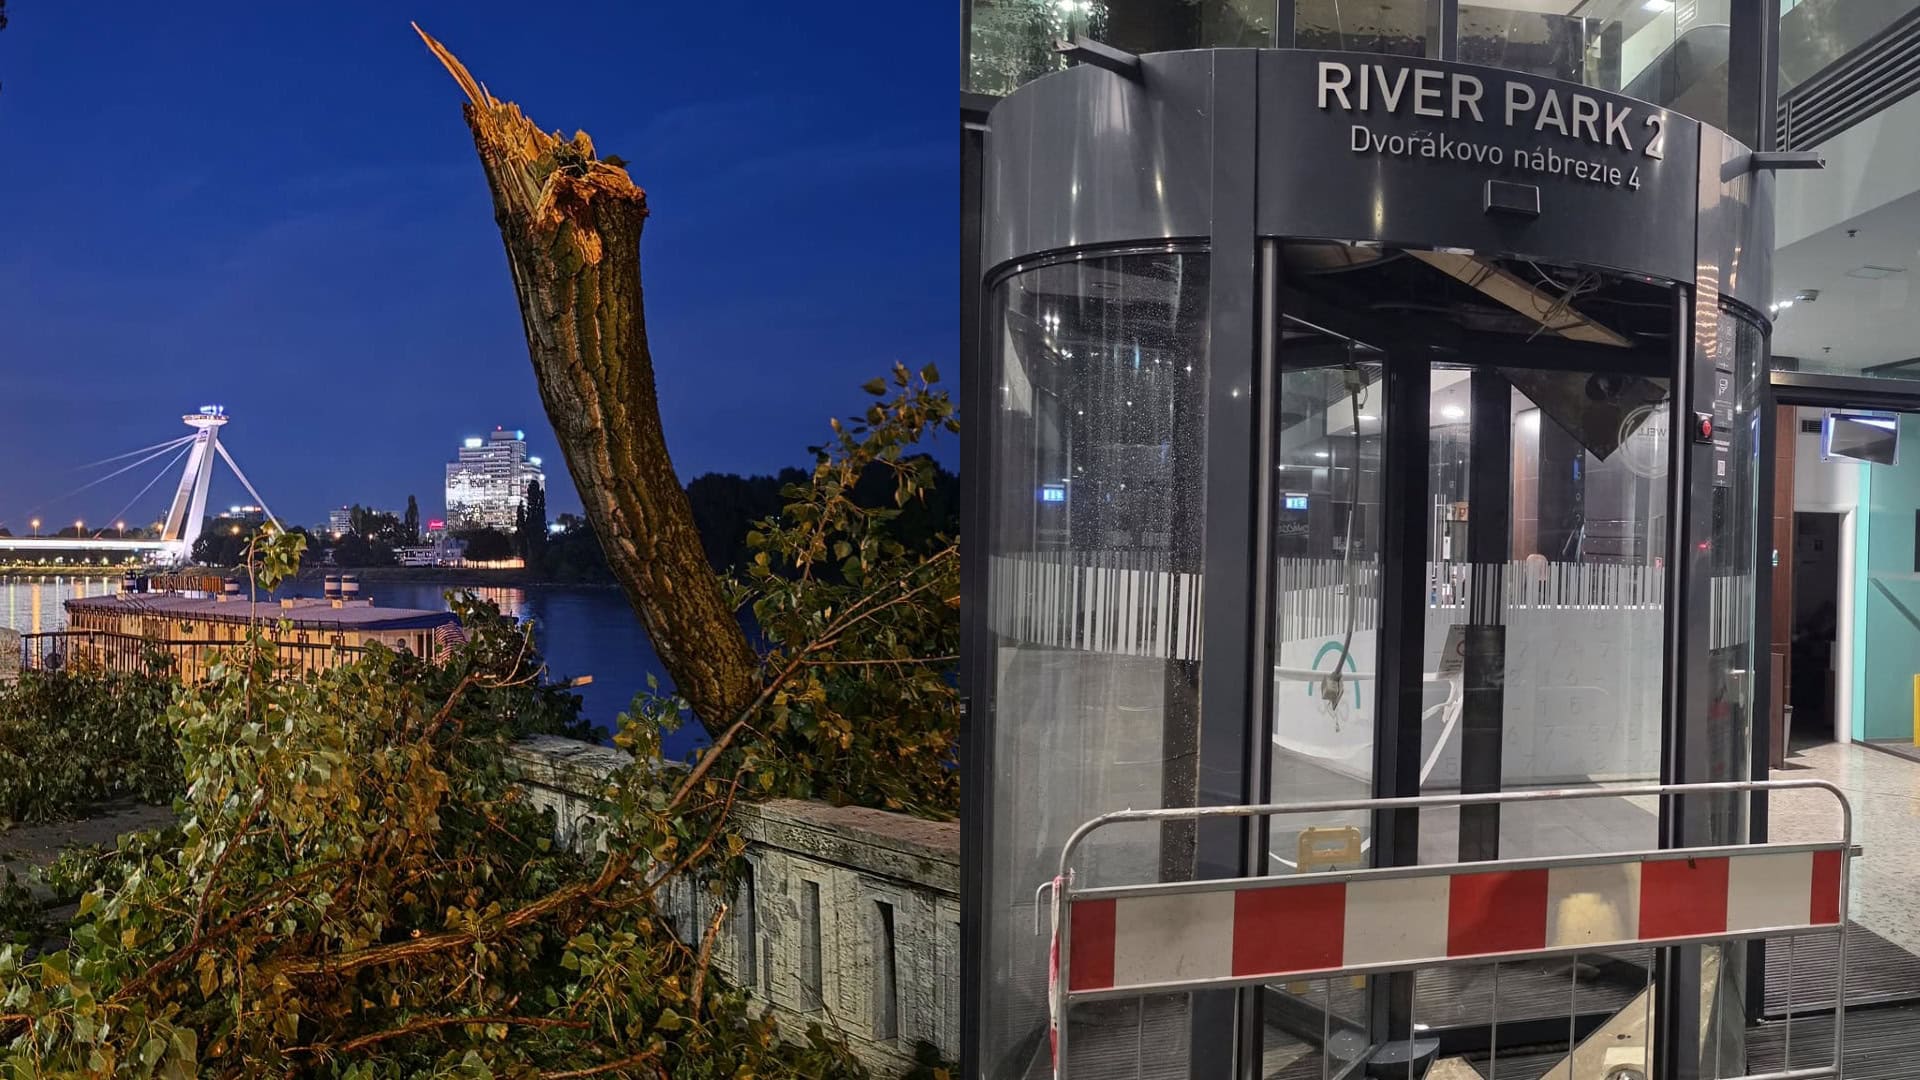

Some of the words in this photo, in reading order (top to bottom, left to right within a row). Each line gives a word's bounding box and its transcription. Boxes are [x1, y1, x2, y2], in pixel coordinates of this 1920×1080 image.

[1318, 61, 1484, 122] RIVER
[1505, 80, 1633, 151] PARK
[1644, 114, 1665, 160] 2
[1628, 166, 1641, 191] 4
